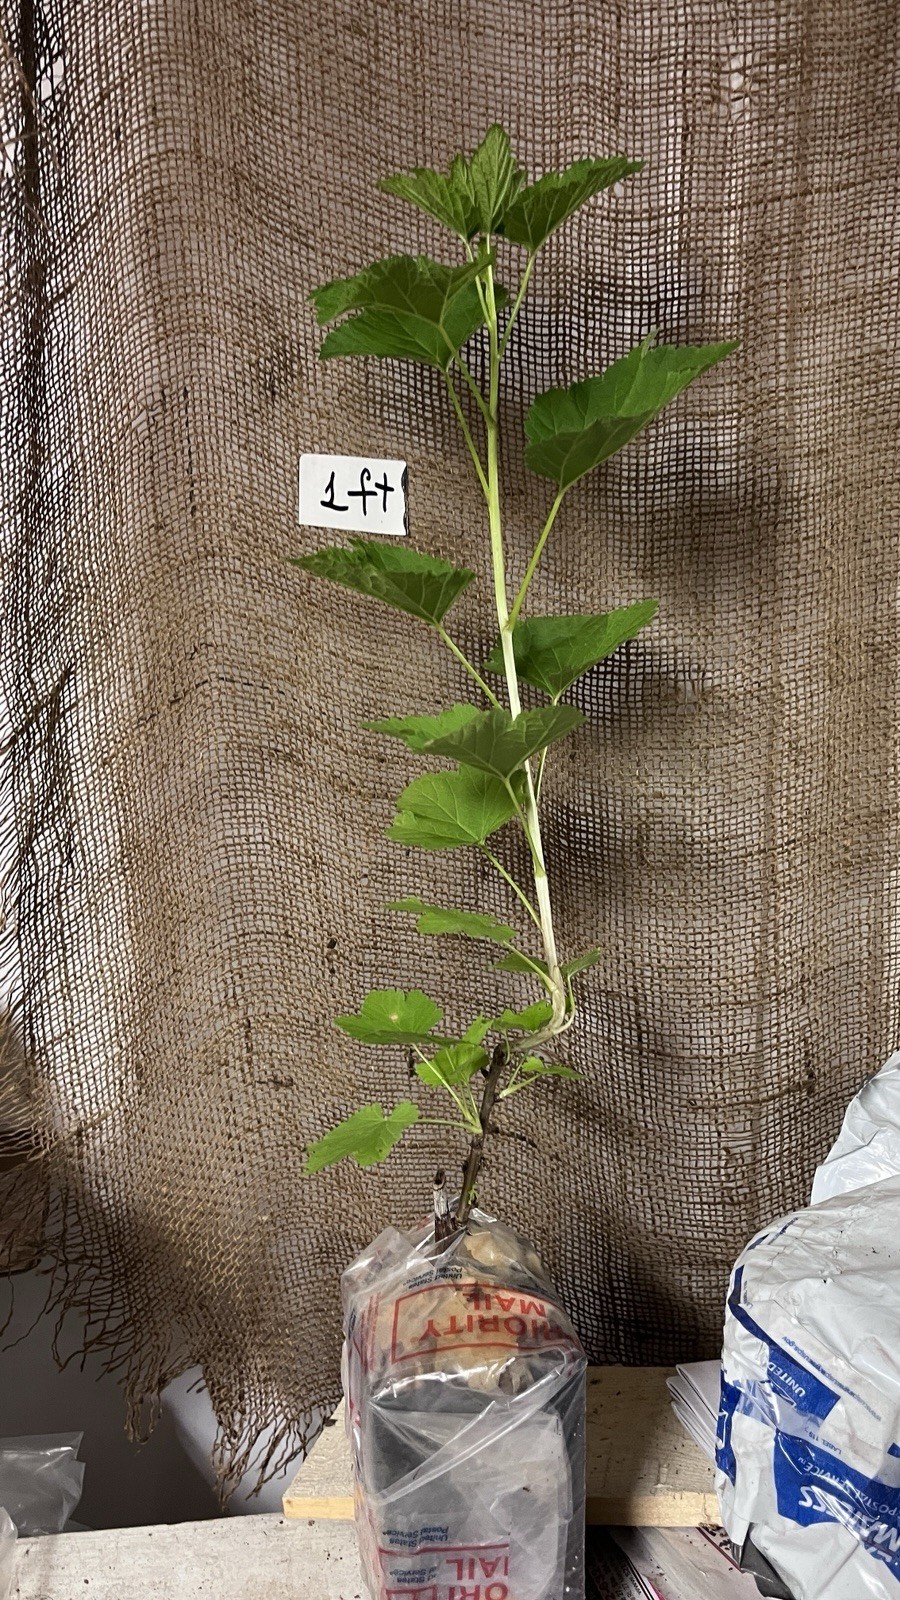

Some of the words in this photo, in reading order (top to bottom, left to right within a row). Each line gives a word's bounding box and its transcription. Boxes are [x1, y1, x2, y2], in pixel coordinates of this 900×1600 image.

[463, 1292, 546, 1317] MAIL
[767, 1361, 806, 1397] UNITED
[420, 1526, 449, 1536] Postal
[389, 1538, 417, 1548] States
[419, 1534, 449, 1544] United
